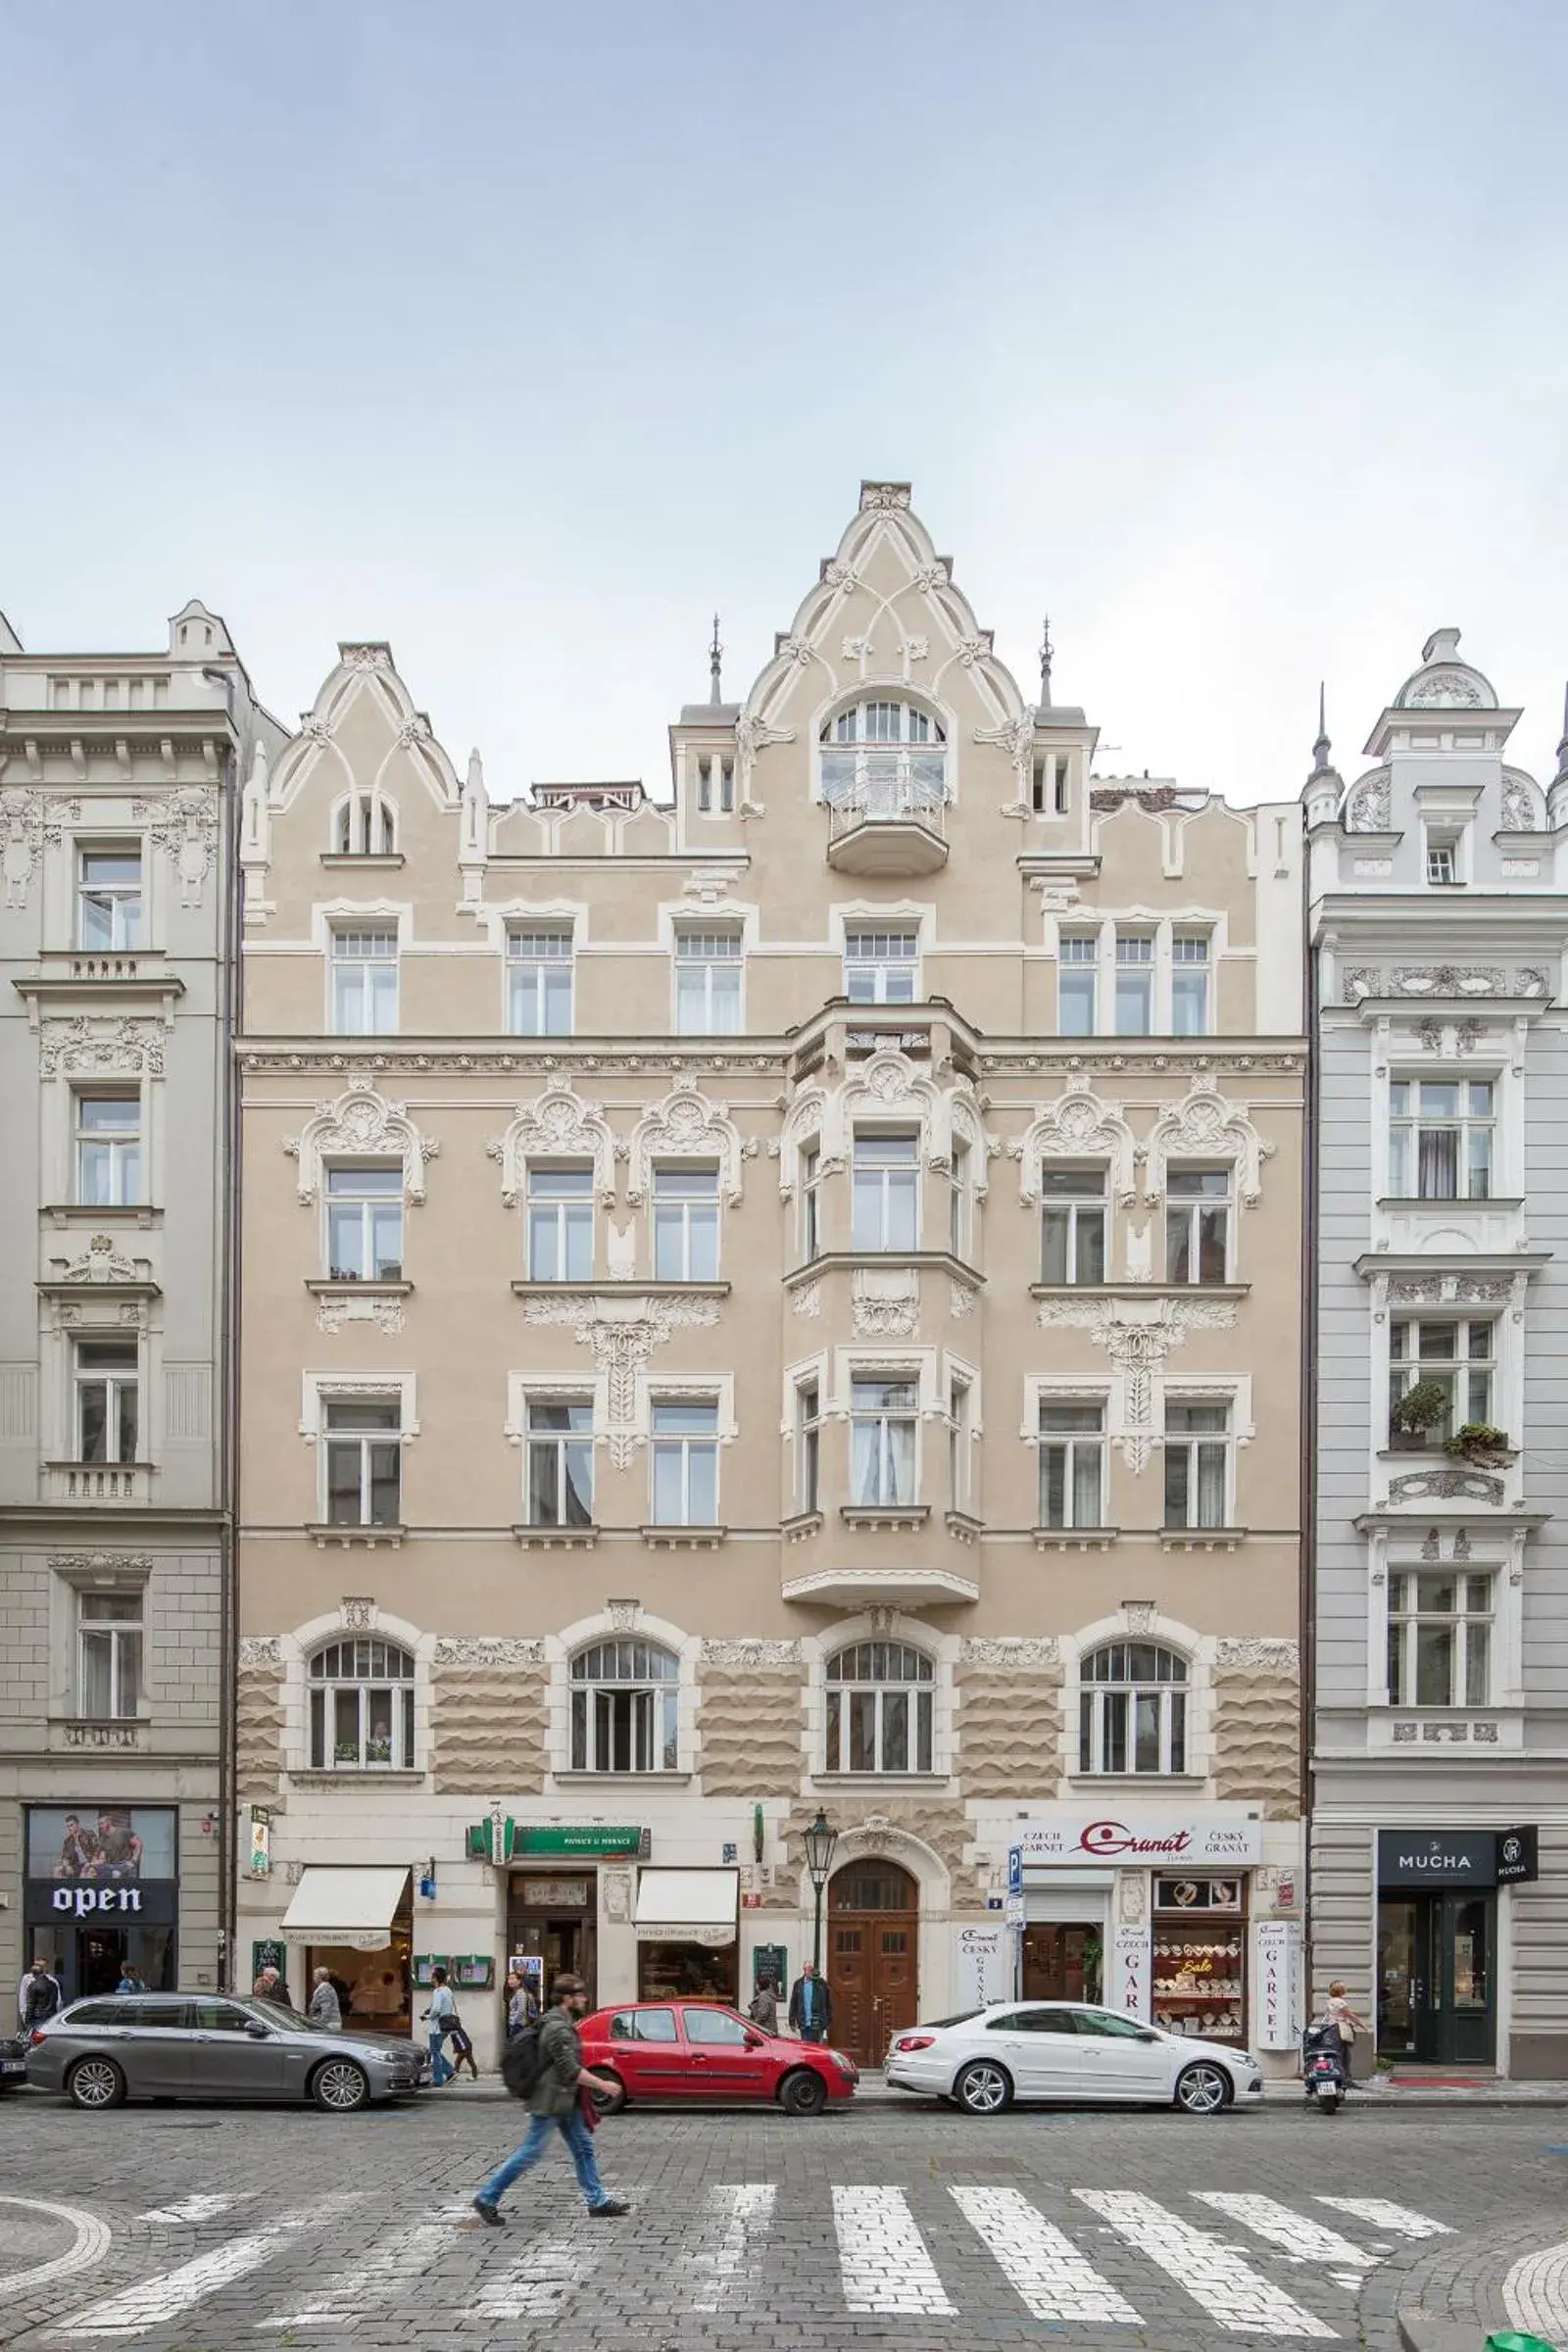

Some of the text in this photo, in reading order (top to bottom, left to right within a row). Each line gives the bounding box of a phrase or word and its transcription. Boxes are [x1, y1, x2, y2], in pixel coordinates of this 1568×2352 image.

[1023, 1831, 1061, 1840] CZECH
[1010, 1852, 1019, 1882] P
[1398, 1855, 1472, 1868] MUCHA
[1498, 1865, 1527, 1876] MUCHA
[52, 1887, 142, 1918] open
[1182, 1958, 1213, 1973] Sale
[1125, 1955, 1140, 2019] GAR
[1266, 1950, 1278, 2042] GARNET
